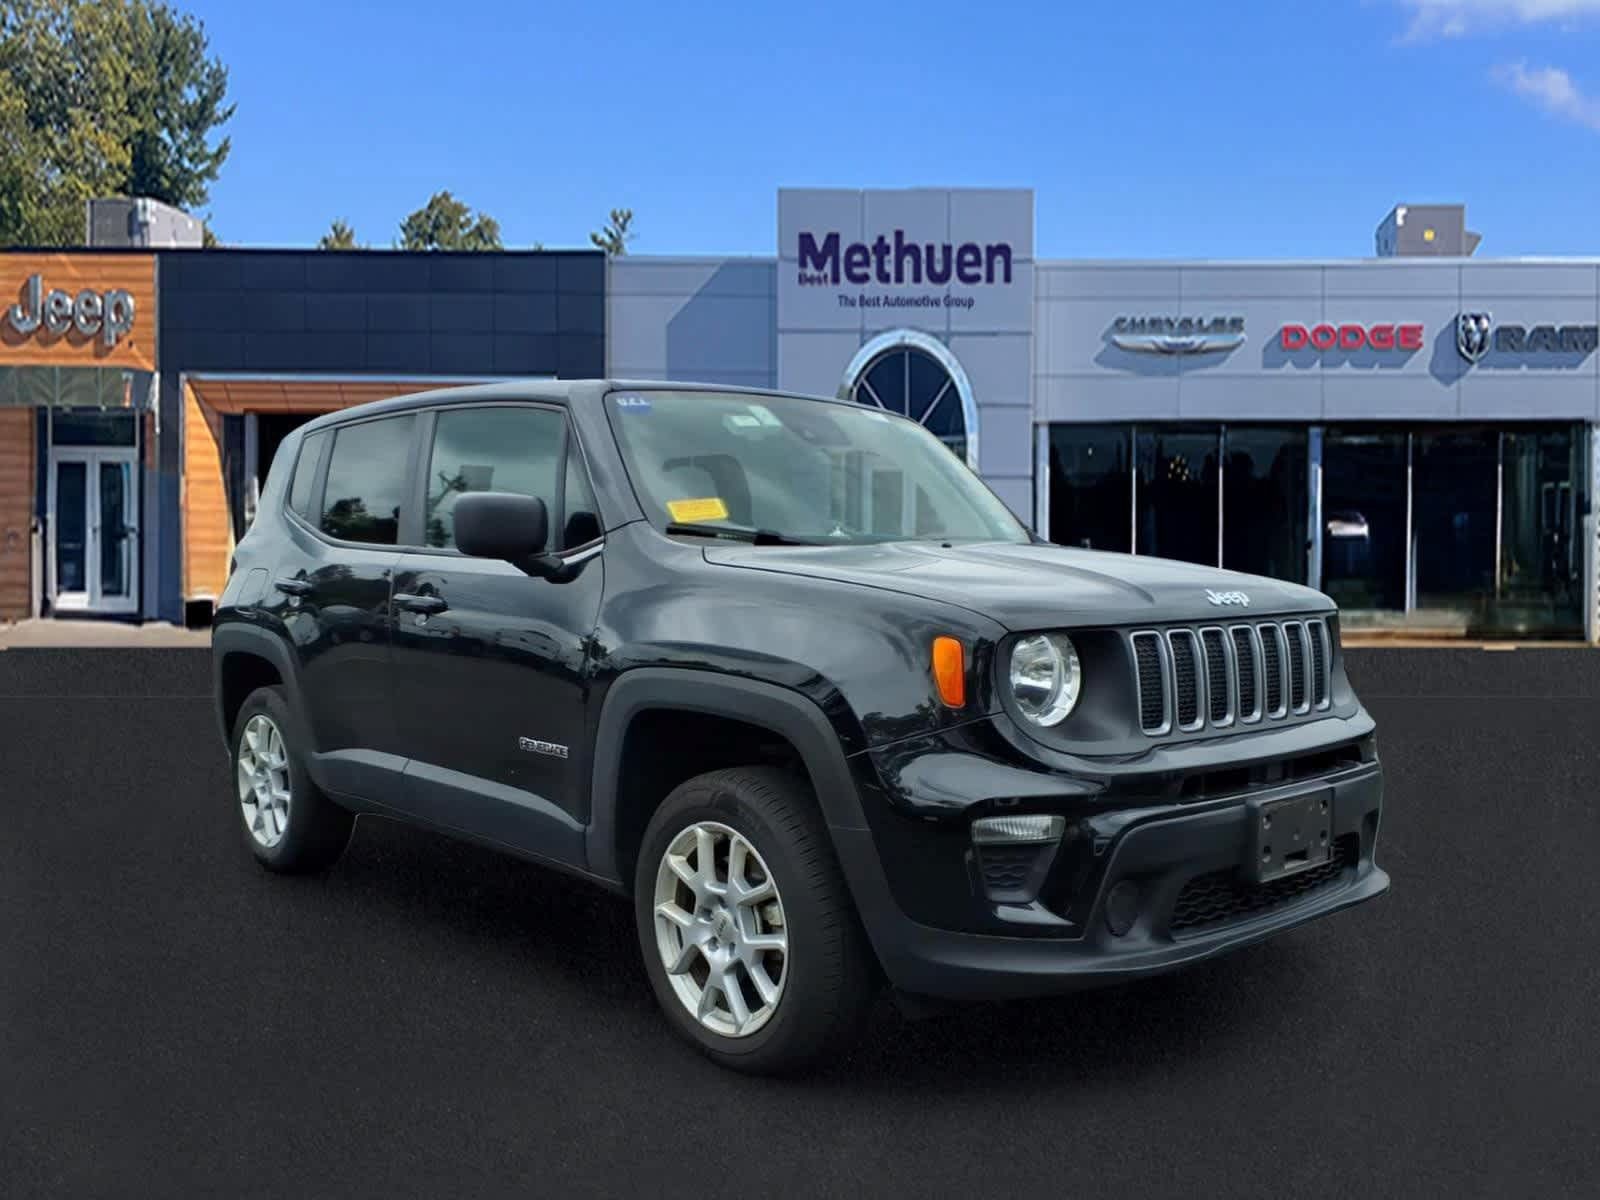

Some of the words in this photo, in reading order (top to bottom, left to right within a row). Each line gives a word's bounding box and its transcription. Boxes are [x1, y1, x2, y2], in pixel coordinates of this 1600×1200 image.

[798, 230, 1012, 285] Methuen
[798, 271, 829, 286] Best
[9, 274, 135, 346] Jeep
[838, 295, 857, 307] The
[859, 295, 881, 307] Best
[883, 295, 941, 307] Automotive
[943, 295, 975, 310] Group
[1114, 317, 1245, 332] CHRYSLER
[1281, 323, 1424, 350] DODGE
[1496, 325, 1598, 352] RAM
[1205, 588, 1250, 607] Jeep
